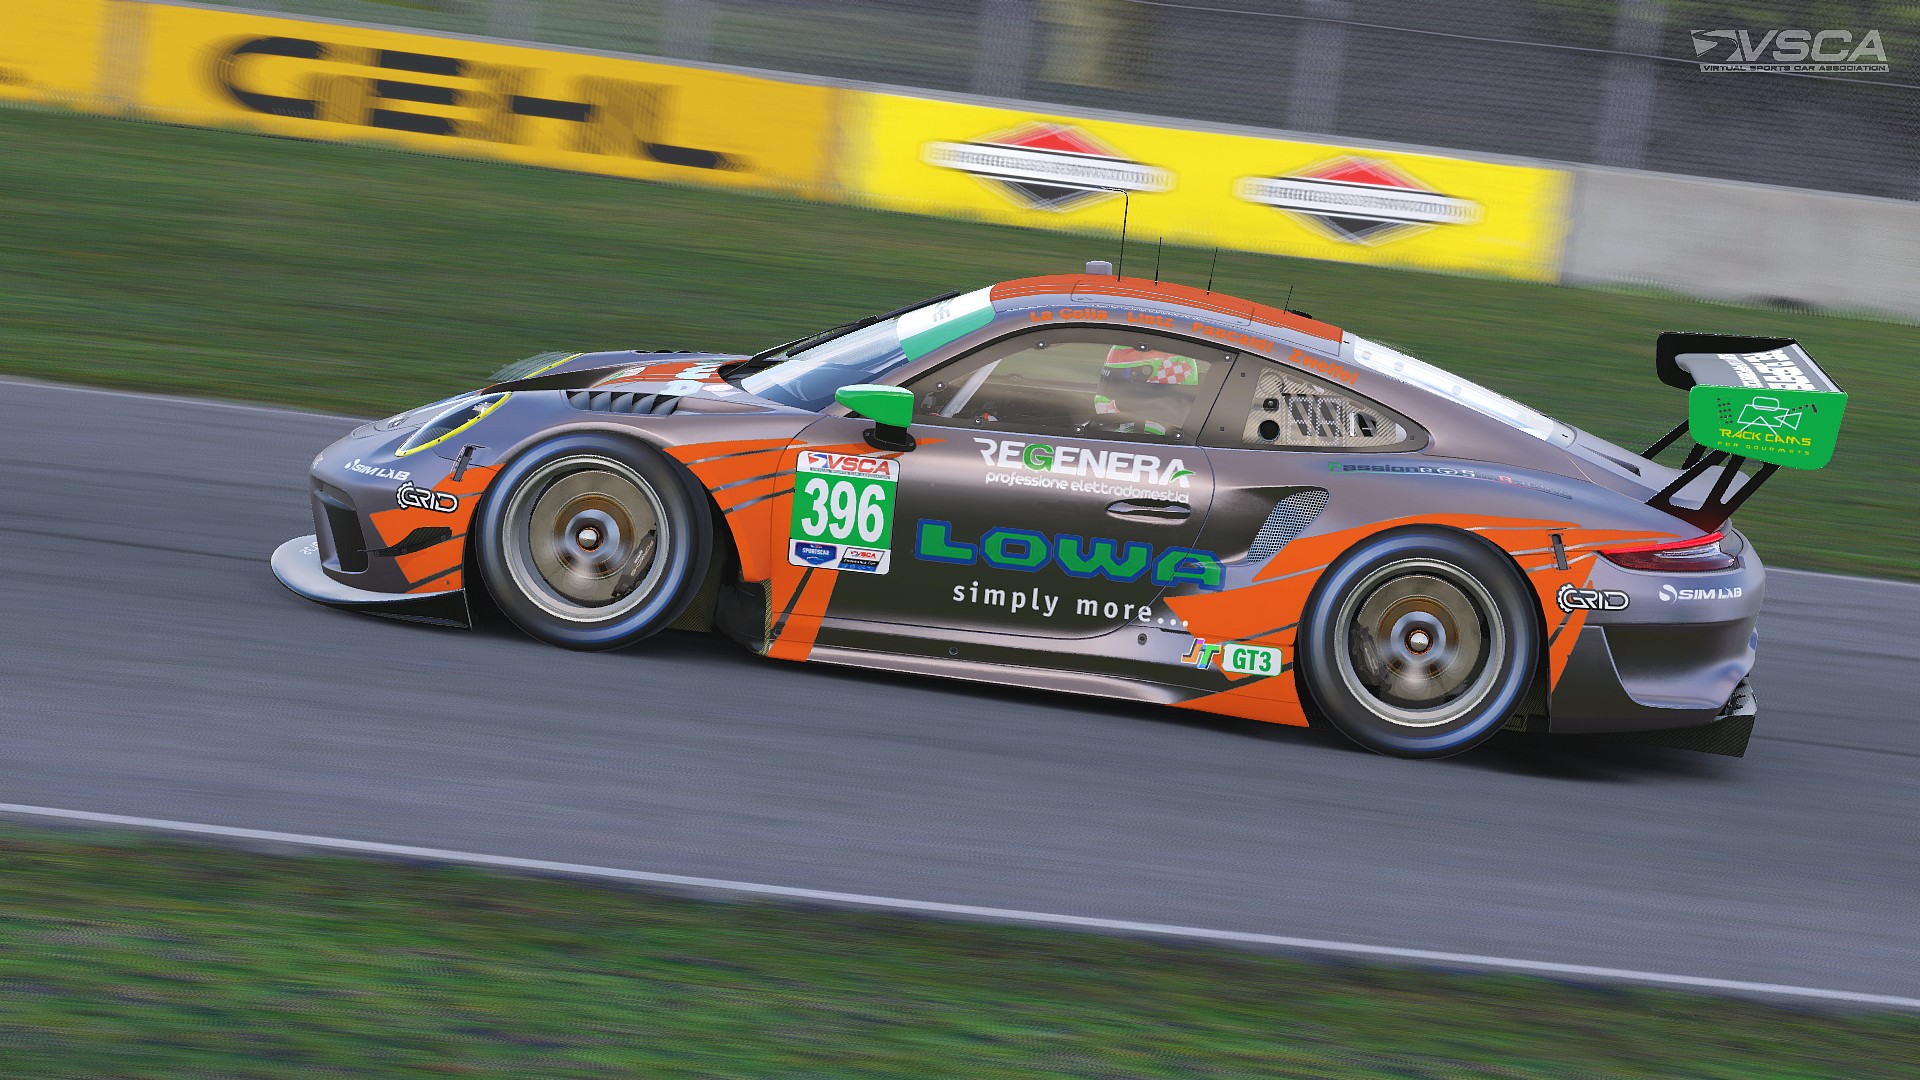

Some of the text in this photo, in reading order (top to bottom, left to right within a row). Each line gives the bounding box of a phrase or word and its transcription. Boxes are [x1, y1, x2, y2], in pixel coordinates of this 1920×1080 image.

[1029, 310, 1053, 322] La
[1127, 311, 1174, 328] Lintz
[1191, 321, 1274, 353] Pancaldi
[1287, 348, 1359, 385] Zweifel
[1719, 428, 1812, 446] TRACK CAMS
[351, 463, 411, 481] SIM LAB
[827, 454, 891, 476] VSCA
[973, 437, 1197, 488] REGENERA
[400, 485, 459, 513] GRID
[985, 471, 1190, 504] professione elettrodomestici
[801, 477, 886, 543] 396
[913, 518, 1227, 592] LOWA
[952, 581, 1059, 618] simply
[1562, 590, 1629, 611] GRID
[1678, 587, 1743, 600] SIM LAB
[1232, 647, 1272, 672] GT3
